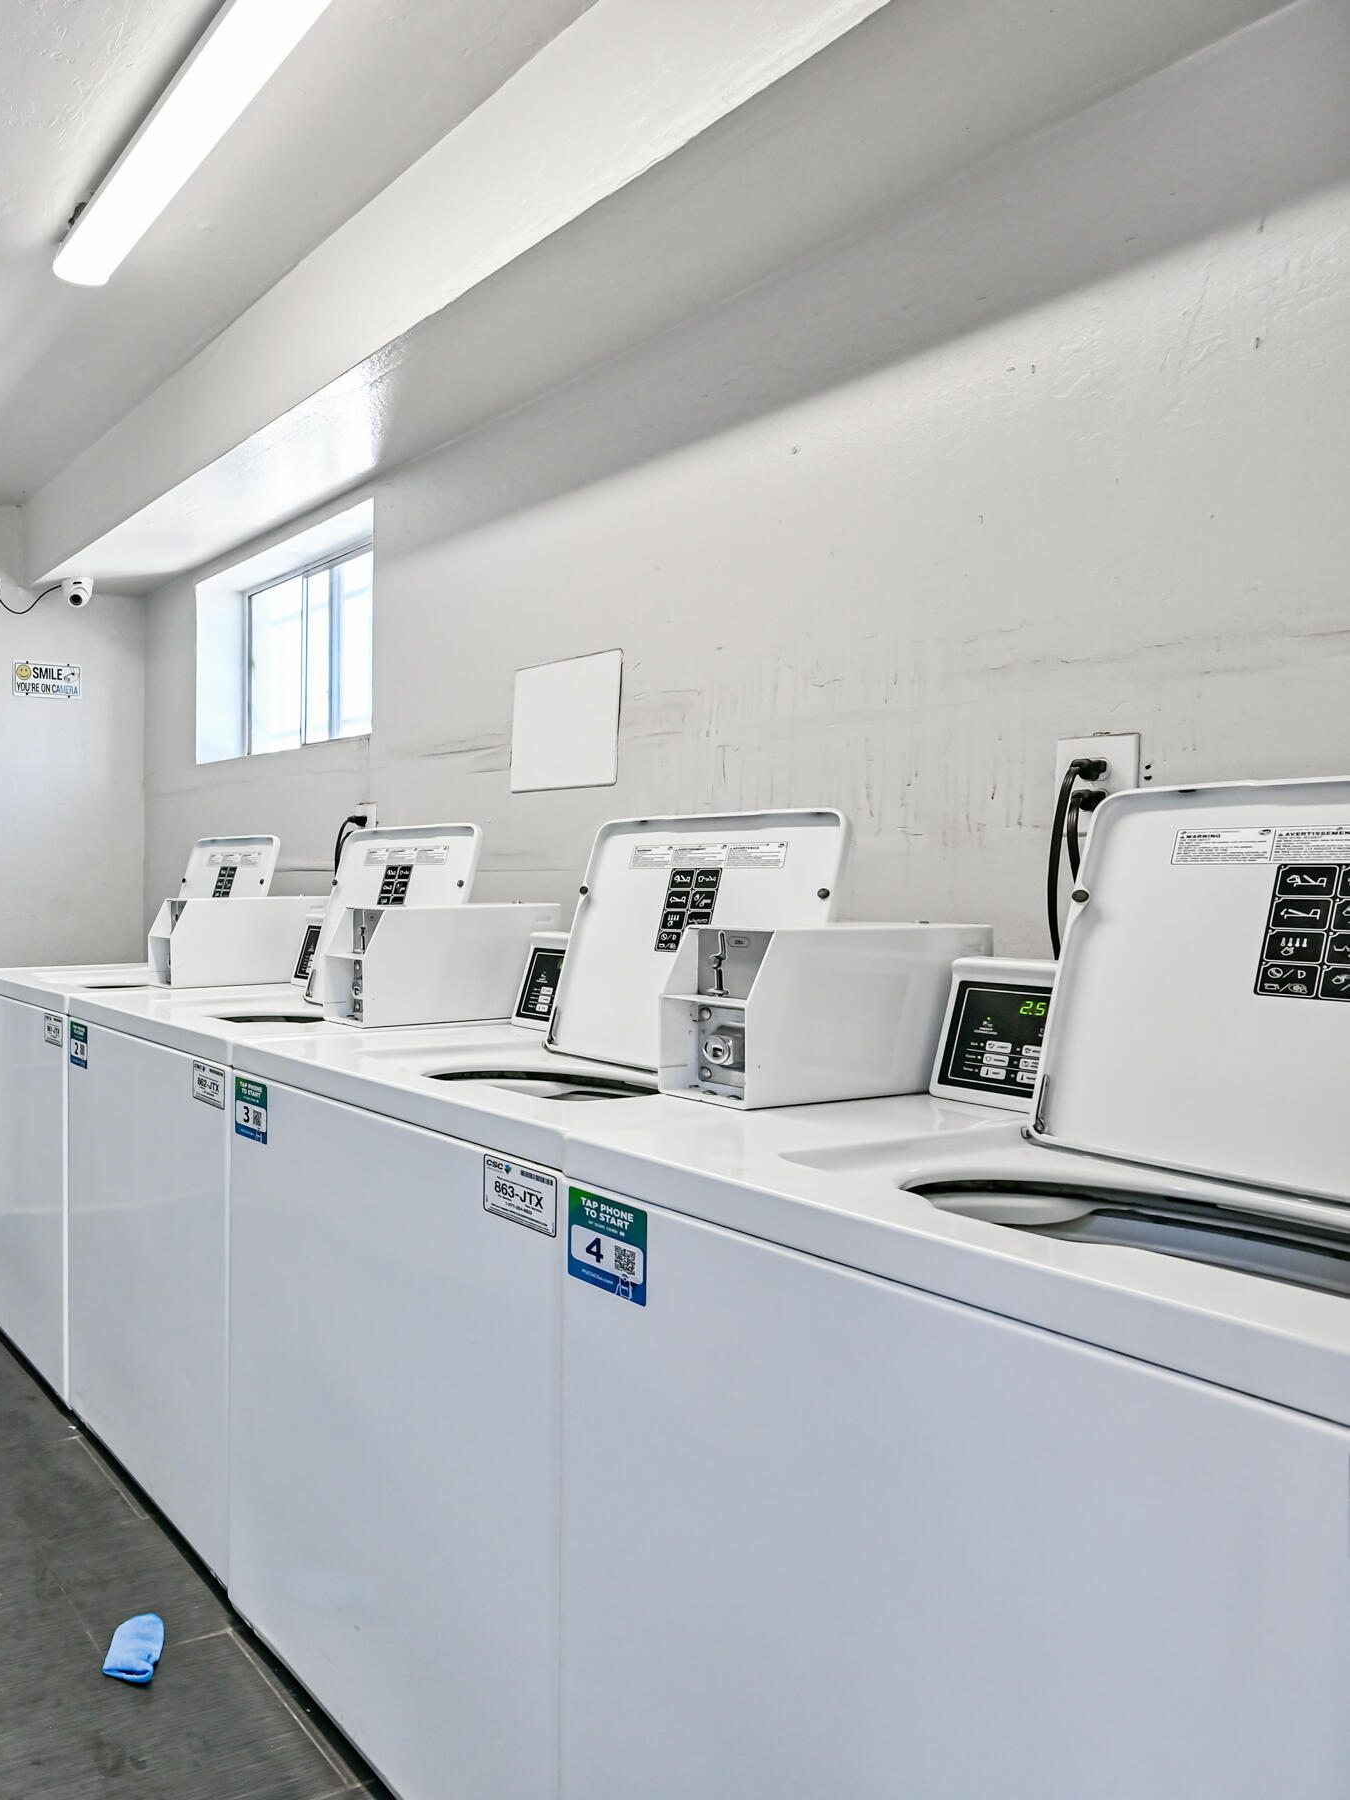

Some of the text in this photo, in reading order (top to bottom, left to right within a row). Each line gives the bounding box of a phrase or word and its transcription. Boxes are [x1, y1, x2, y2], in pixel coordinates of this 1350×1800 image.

[32, 667, 63, 681] SMILE
[16, 682, 78, 695] YOU'RE ON CAMERA
[74, 1042, 79, 1055] 2
[243, 1105, 250, 1123] 3
[486, 1159, 504, 1170] CSC
[494, 1180, 544, 1210] 863-JTX
[580, 1196, 634, 1223] TAP PHONE
[584, 1207, 630, 1231] TO START
[585, 1237, 604, 1264] 4
